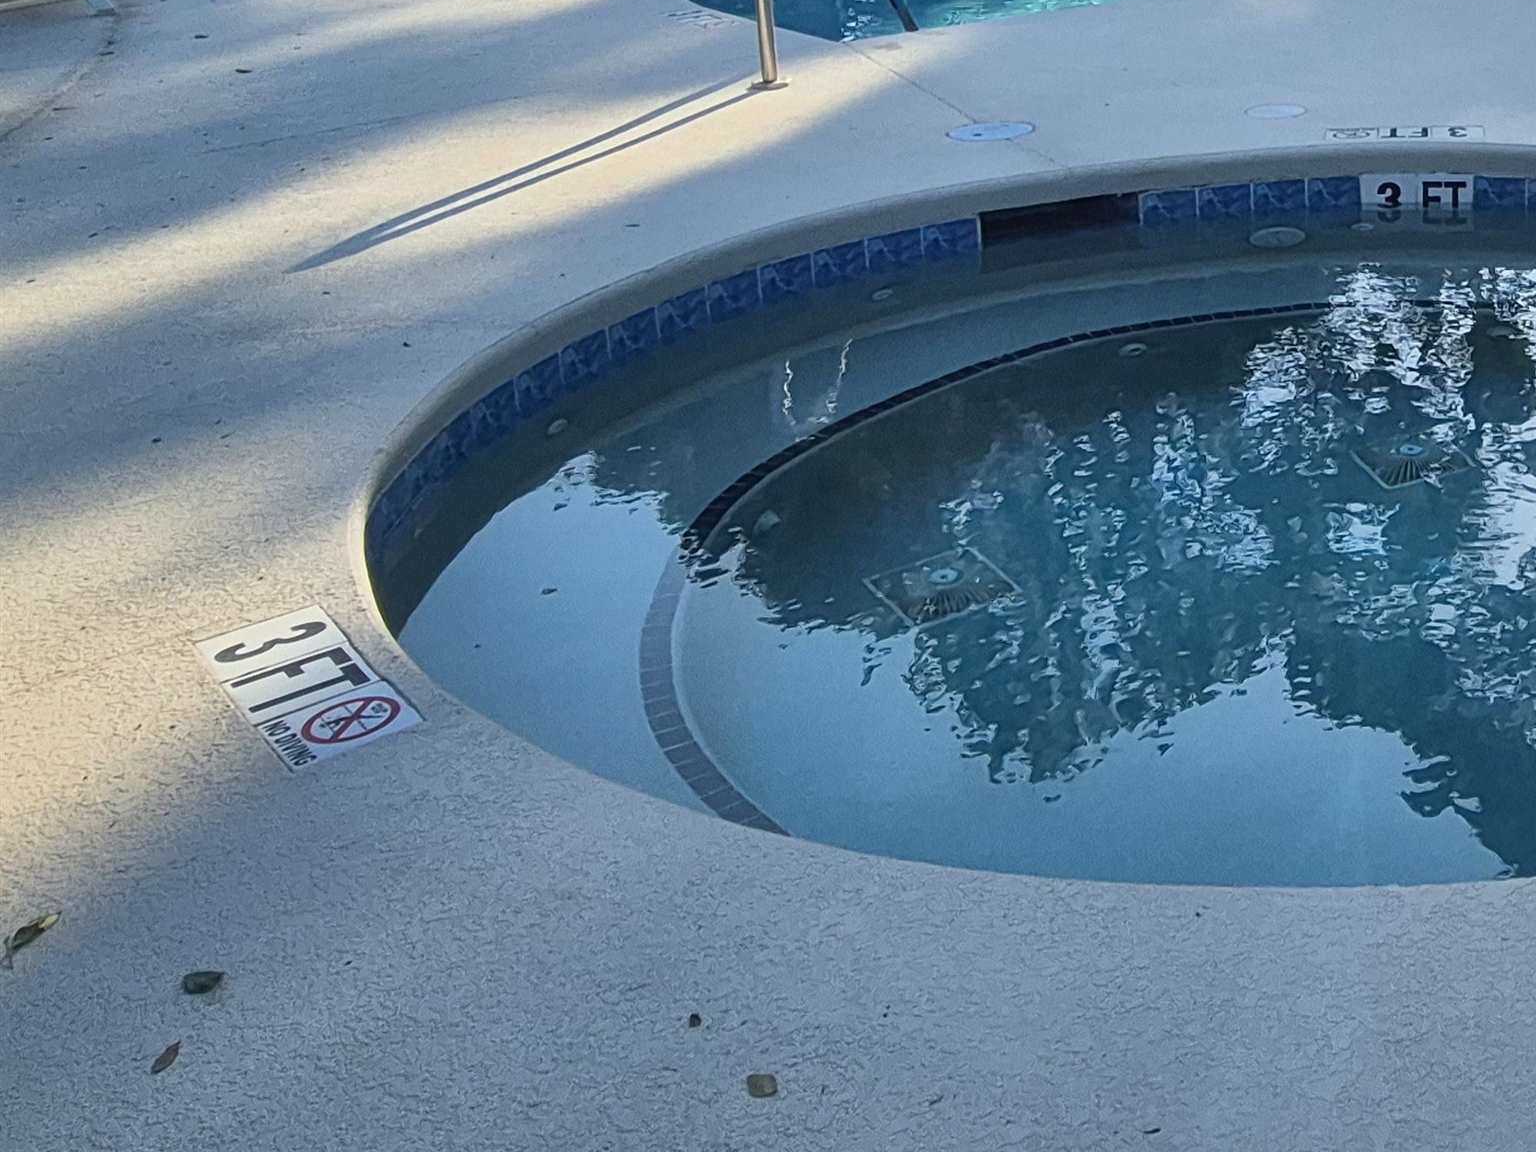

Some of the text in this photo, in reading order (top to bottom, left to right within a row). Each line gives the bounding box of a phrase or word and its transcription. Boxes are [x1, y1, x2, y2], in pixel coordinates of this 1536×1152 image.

[1381, 127, 1430, 139] FT
[1376, 181, 1467, 209] 3 FT
[214, 621, 371, 714] 3 FT
[262, 719, 318, 767] NO DIVING
